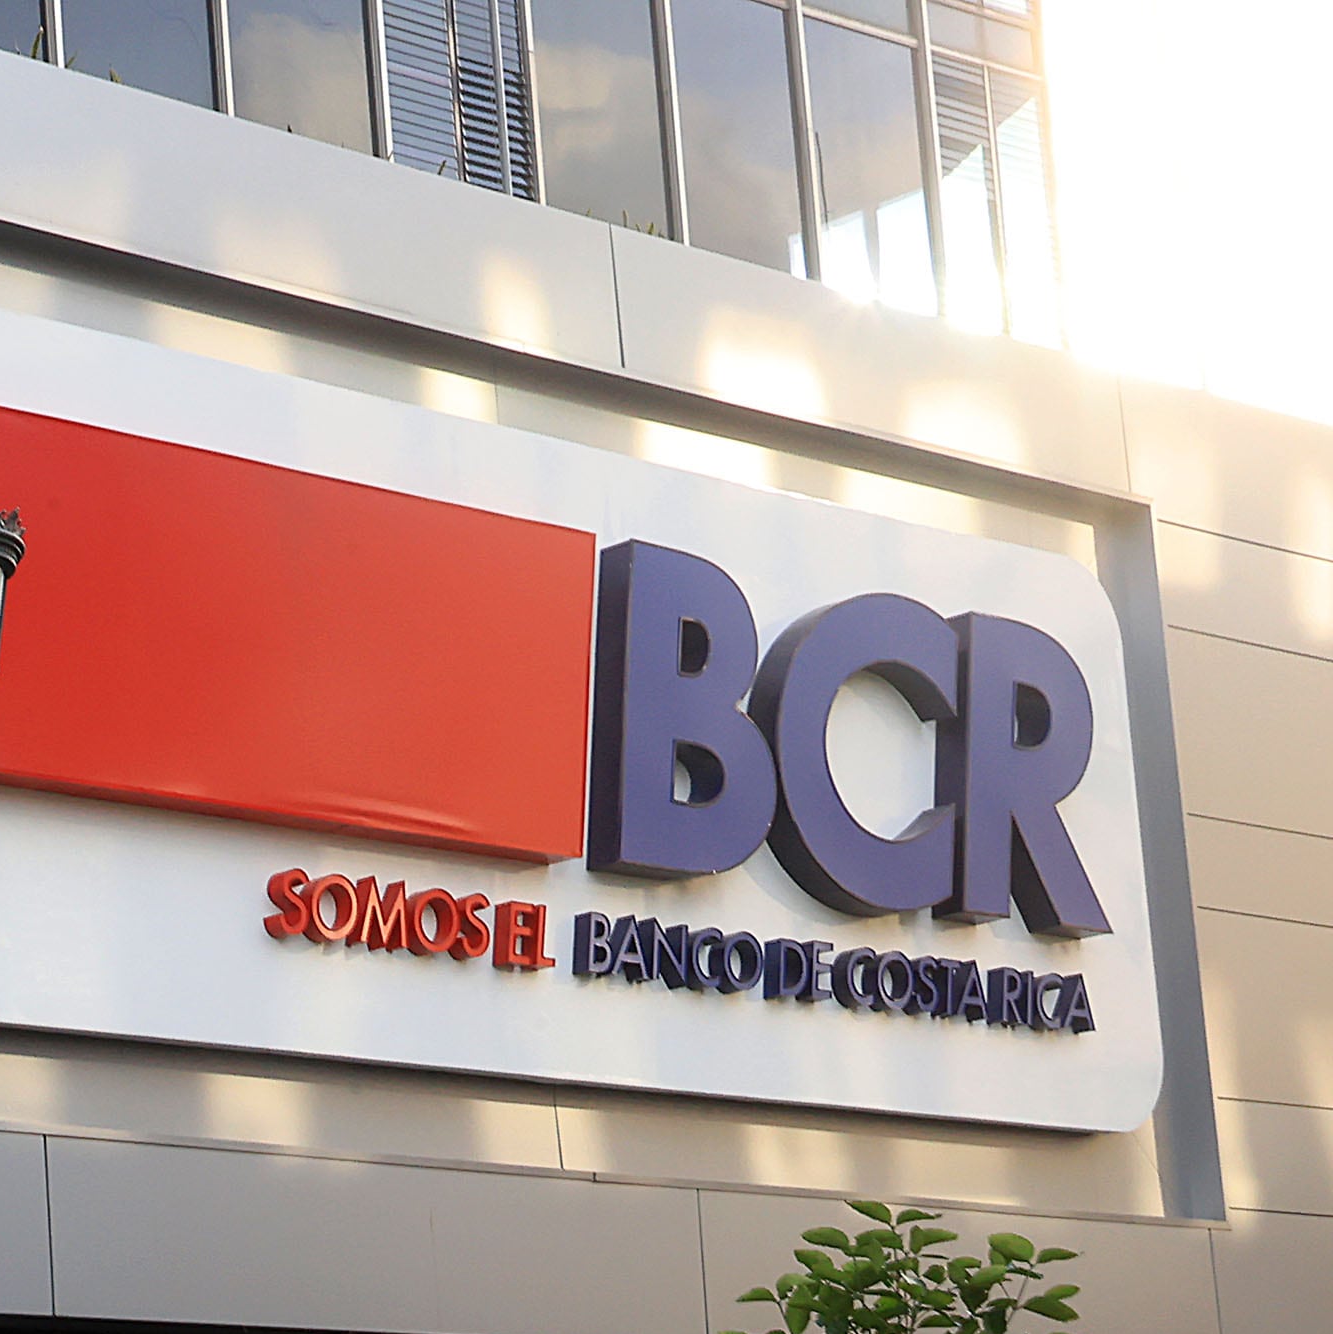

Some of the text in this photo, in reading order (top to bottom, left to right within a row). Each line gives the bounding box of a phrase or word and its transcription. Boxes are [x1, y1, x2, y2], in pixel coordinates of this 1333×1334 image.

[587, 538, 1113, 940] BCR
[263, 868, 1096, 1035] SOMOS EL BANCO DE COSTA RICA
